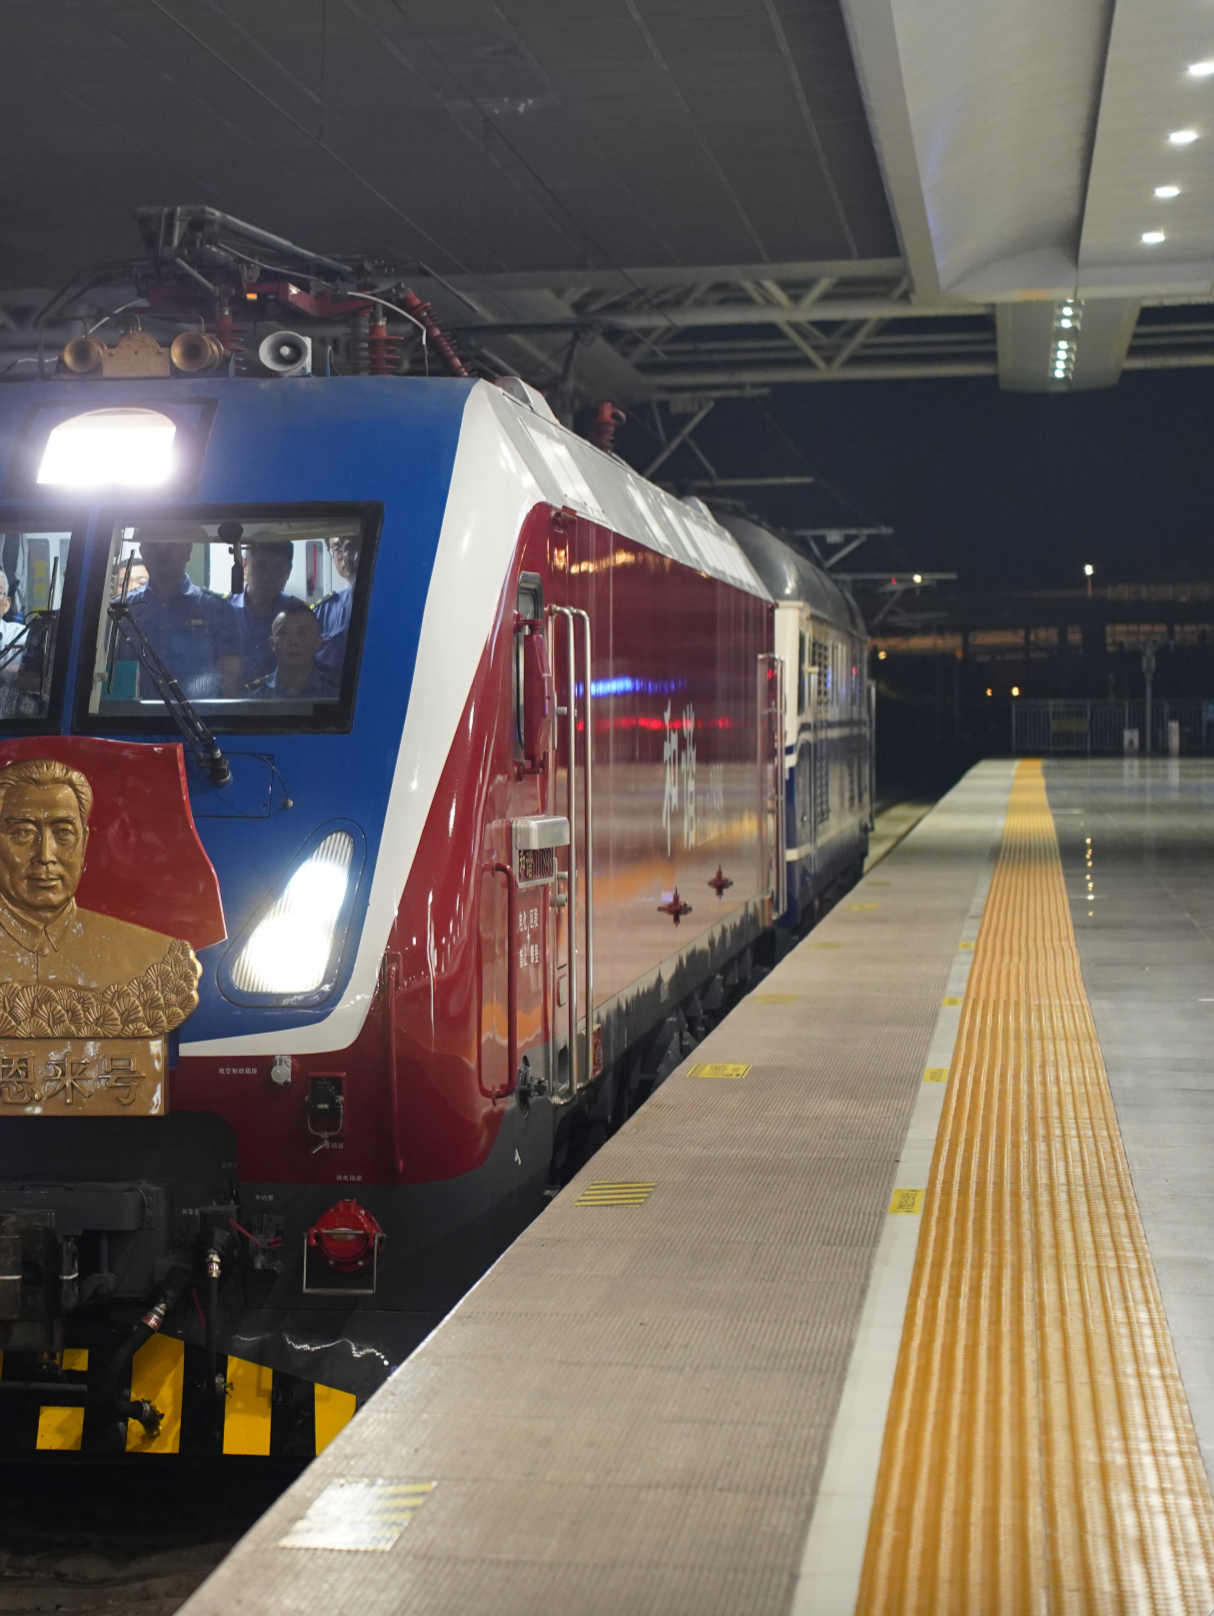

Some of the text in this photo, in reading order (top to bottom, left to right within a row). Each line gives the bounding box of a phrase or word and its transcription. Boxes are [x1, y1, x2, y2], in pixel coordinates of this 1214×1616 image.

[218, 1067, 258, 1075] 电空制动插座
[336, 1174, 363, 1182] 供电插座
